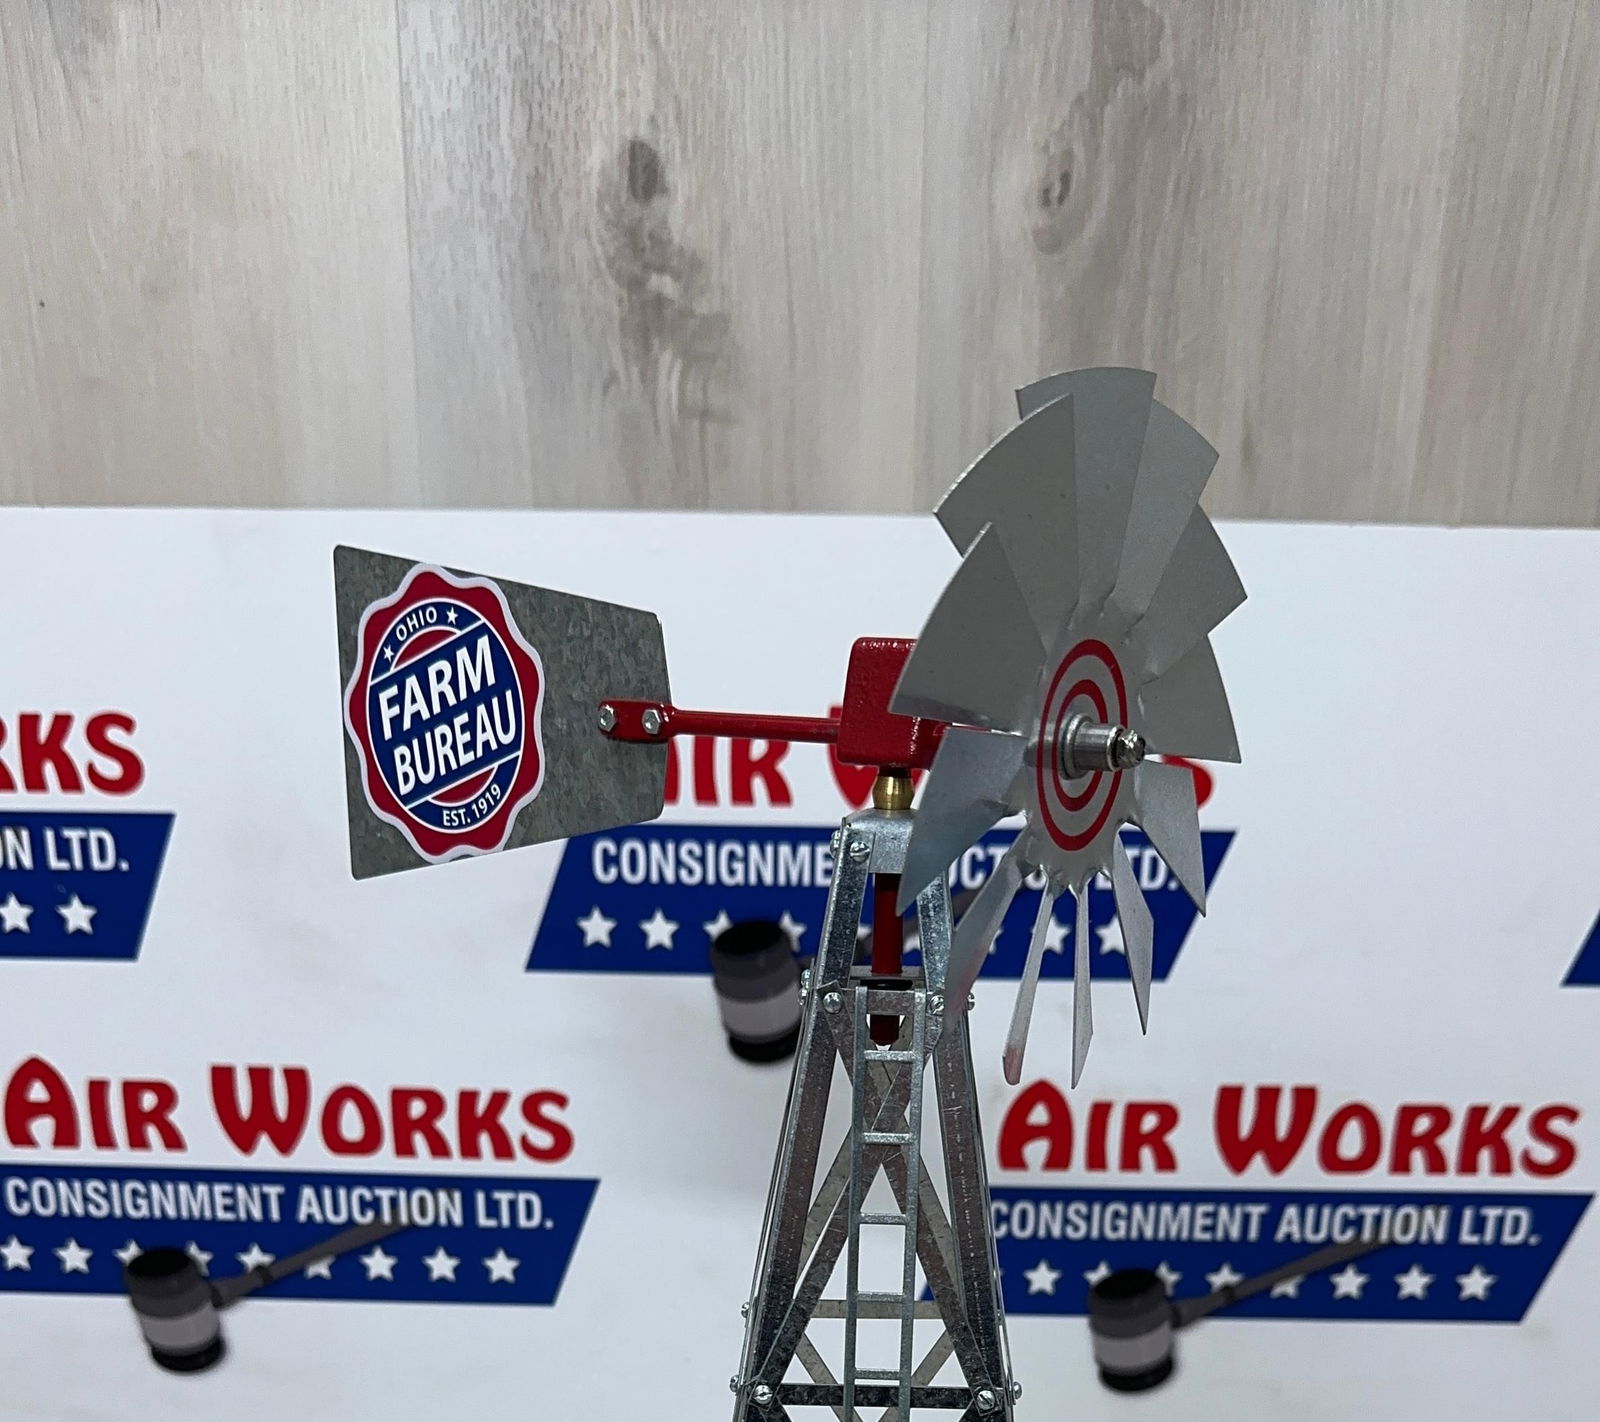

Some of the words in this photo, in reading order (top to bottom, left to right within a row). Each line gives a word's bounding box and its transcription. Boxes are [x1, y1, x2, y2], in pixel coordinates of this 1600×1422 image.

[396, 606, 437, 642] OHIO
[378, 634, 496, 741] FARM
[0, 710, 145, 797] KS
[393, 690, 517, 796] BUREAU
[664, 735, 793, 807] IR
[443, 808, 471, 827] EST.
[471, 783, 501, 820] 1919
[43, 826, 130, 872] LTD.
[591, 837, 833, 887] CONSIGNME
[3, 1056, 188, 1151] AIR
[210, 1065, 575, 1162] WORKS
[997, 1078, 1180, 1173] AIR
[1213, 1084, 1581, 1178] WORKS
[4, 1176, 285, 1222] CONSIGNMENT
[296, 1184, 463, 1227] AUCTION
[475, 1190, 554, 1229] LTD.
[990, 1200, 1268, 1242] CONSIGNMENT
[1274, 1203, 1448, 1245] AUCTION
[1458, 1206, 1541, 1246] LTD.
